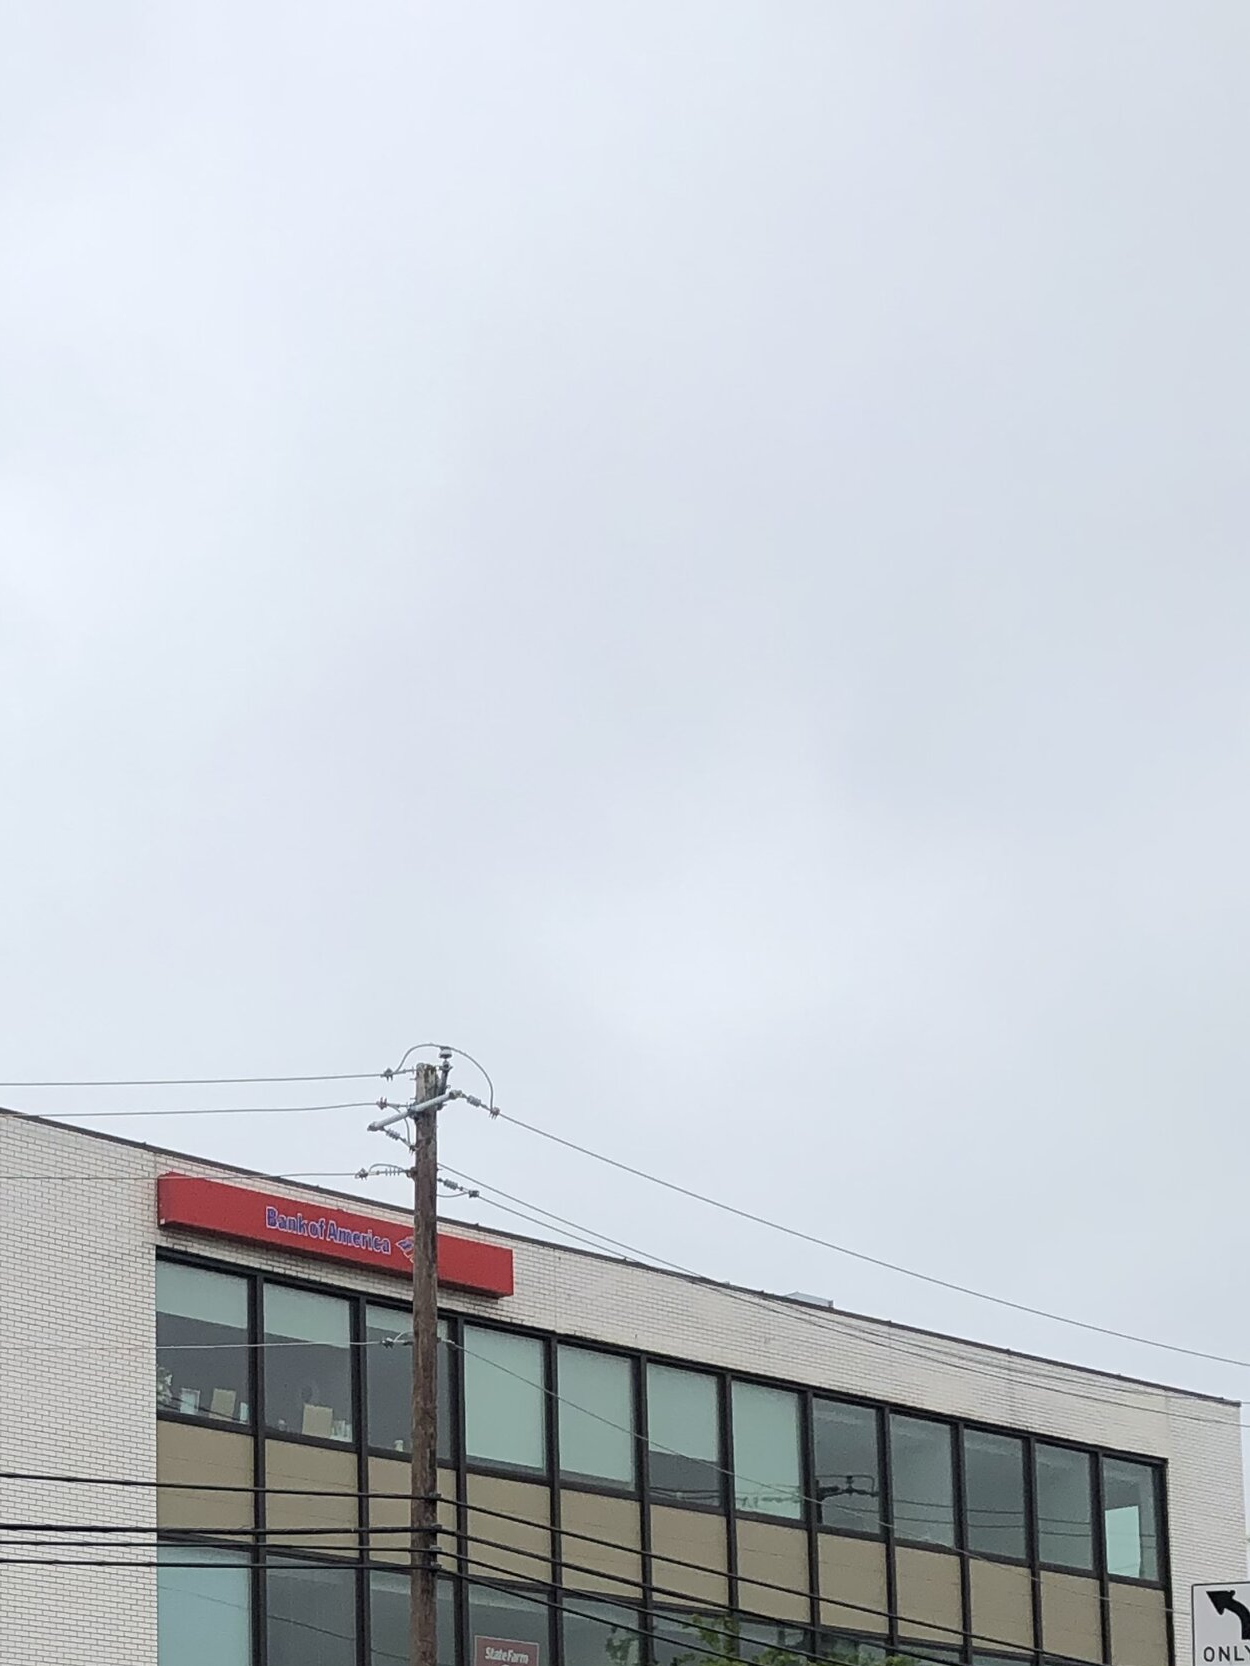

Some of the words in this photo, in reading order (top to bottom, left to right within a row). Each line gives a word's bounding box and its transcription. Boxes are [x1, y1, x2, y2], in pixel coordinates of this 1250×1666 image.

[265, 1206, 308, 1236] Bank
[308, 1218, 326, 1241] of
[326, 1220, 392, 1255] America
